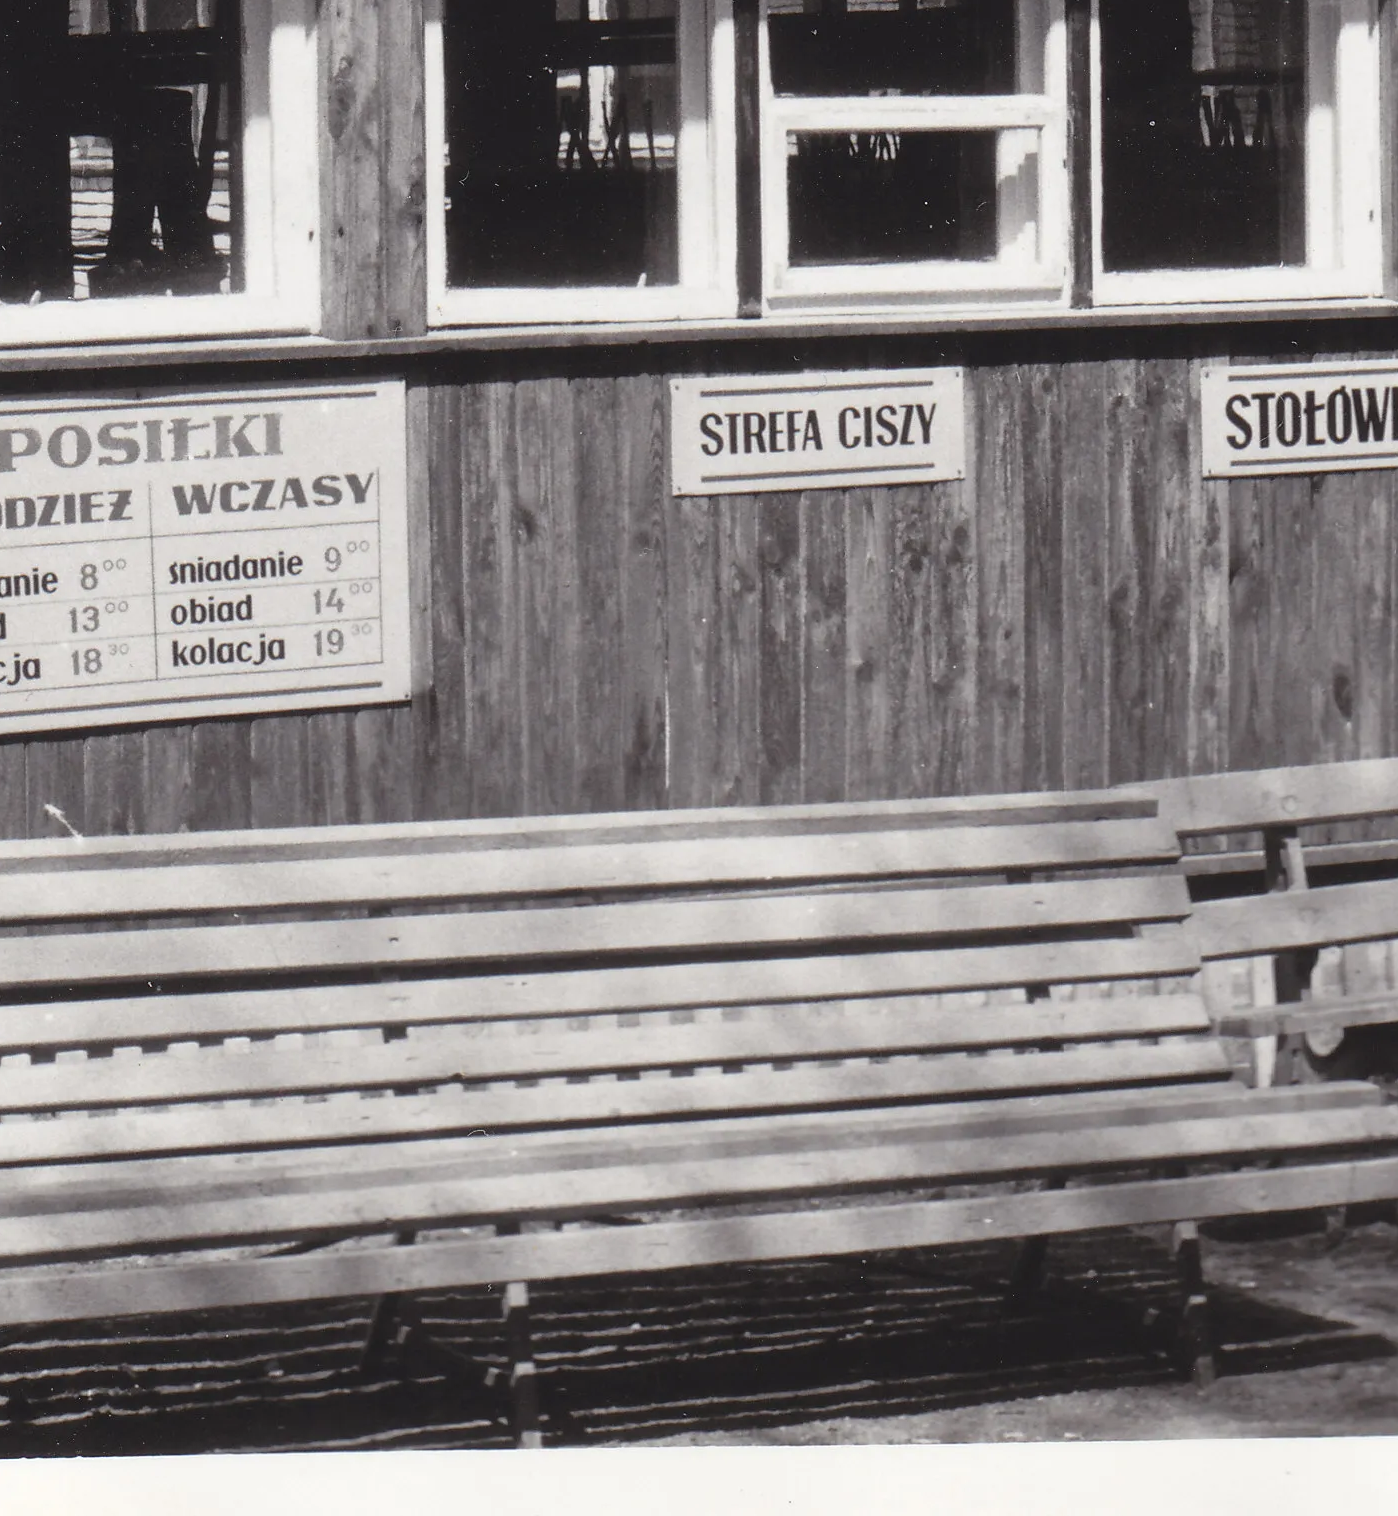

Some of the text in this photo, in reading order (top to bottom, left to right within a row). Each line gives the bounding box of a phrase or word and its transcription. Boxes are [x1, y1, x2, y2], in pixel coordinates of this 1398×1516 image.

[699, 402, 937, 457] STREFA CISZY
[171, 471, 375, 517] WCZASY
[170, 594, 253, 626] obiad
[172, 633, 286, 667] kolacja
